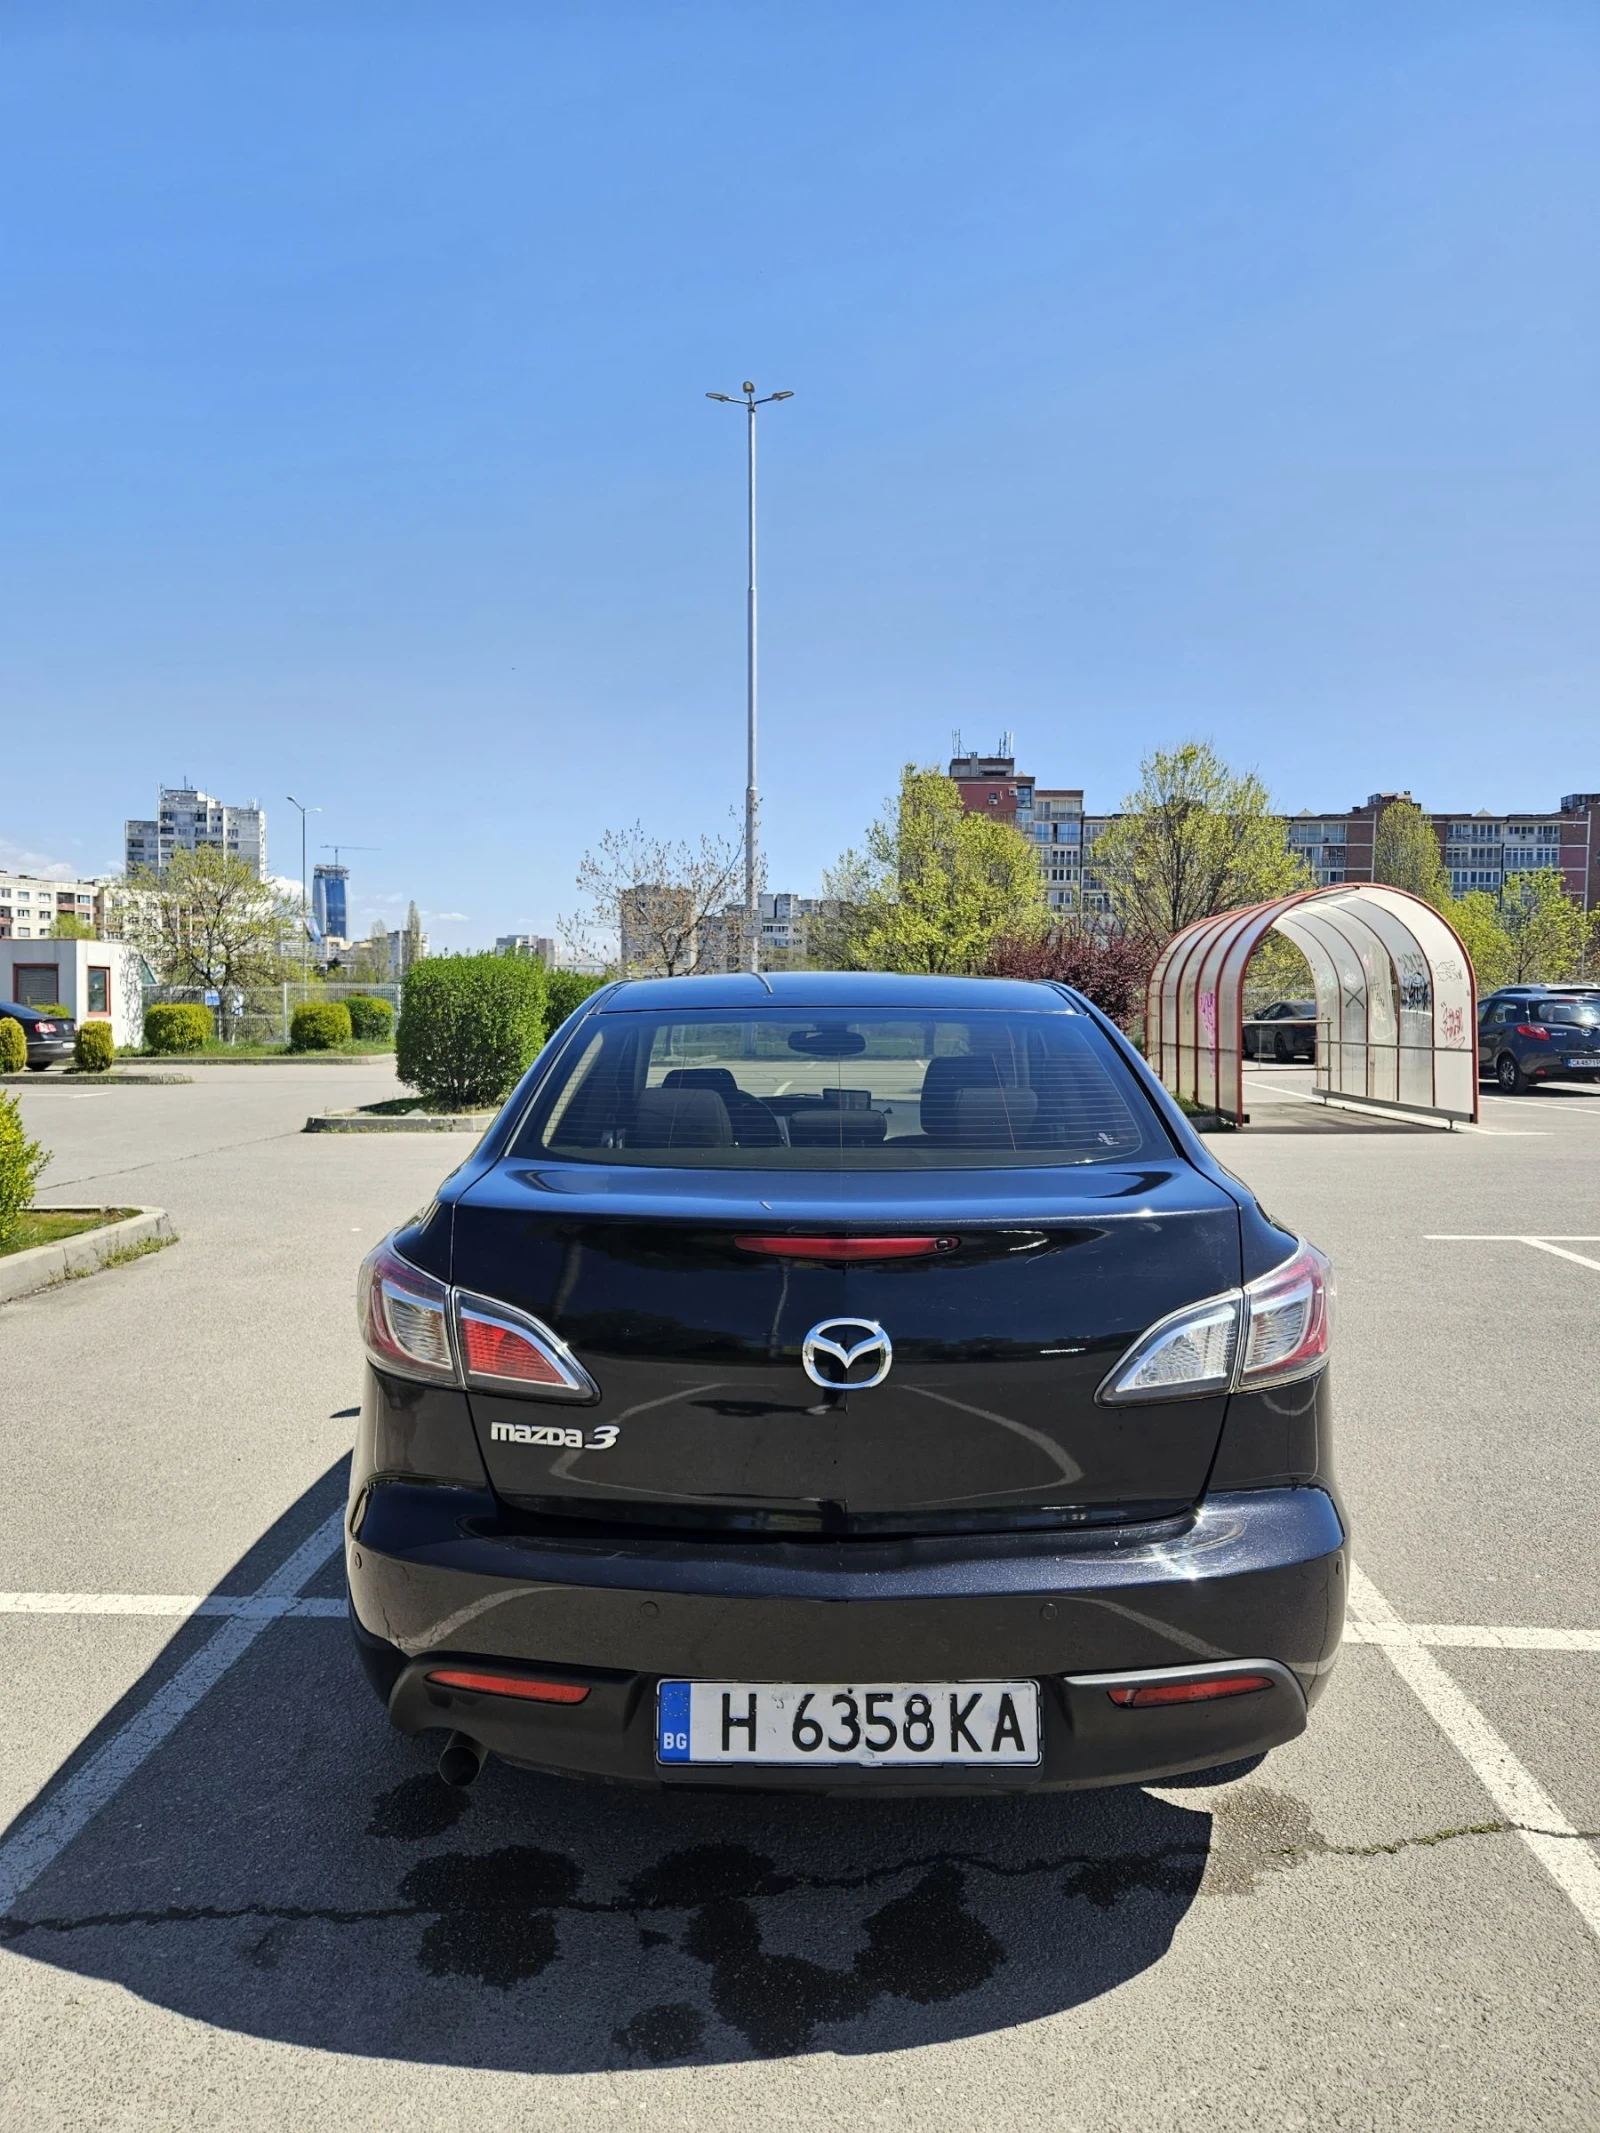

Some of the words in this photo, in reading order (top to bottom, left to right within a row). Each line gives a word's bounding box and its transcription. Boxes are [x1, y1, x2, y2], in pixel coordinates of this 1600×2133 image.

[584, 1425, 620, 1450] 3
[721, 1693, 757, 1752] H
[792, 1693, 935, 1752] 6358
[950, 1693, 1025, 1752] KA
[663, 1733, 687, 1750] BG
